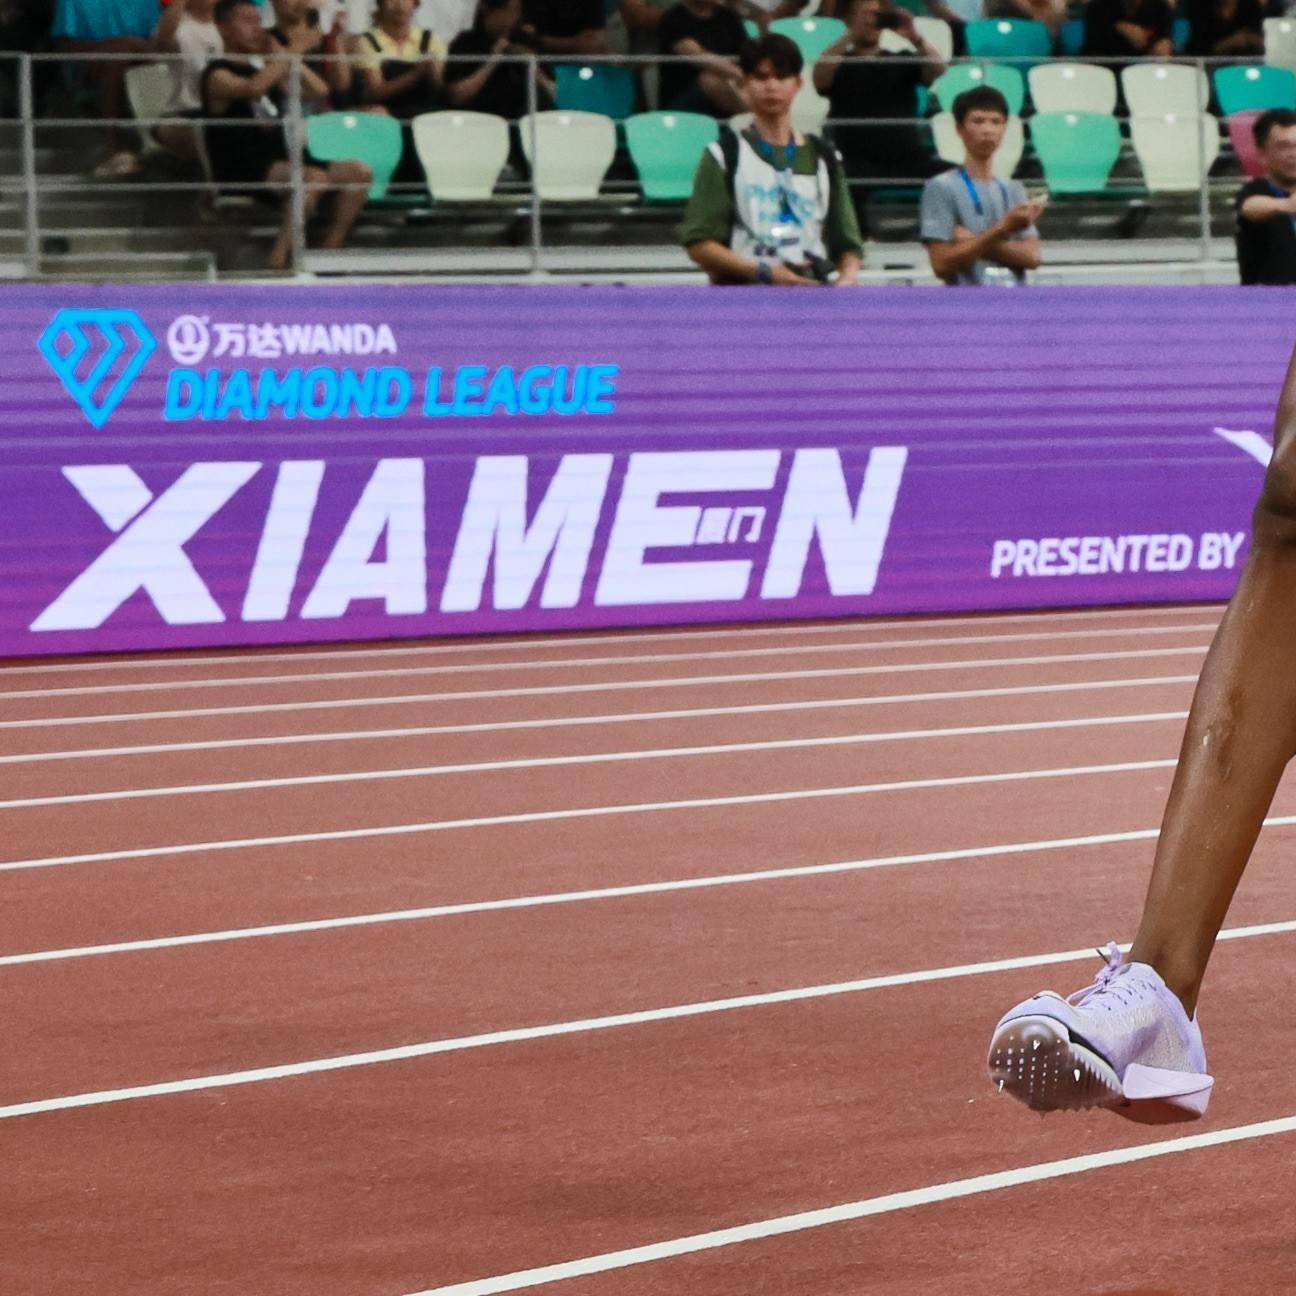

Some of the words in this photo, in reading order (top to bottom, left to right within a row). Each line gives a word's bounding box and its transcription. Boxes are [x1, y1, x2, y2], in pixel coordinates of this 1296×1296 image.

[164, 365, 413, 421] DIAMOND
[423, 364, 620, 419] LEAGUE
[28, 446, 909, 633] XIAMEN
[991, 534, 1194, 578] PRESENTED
[1197, 532, 1244, 570] BY
